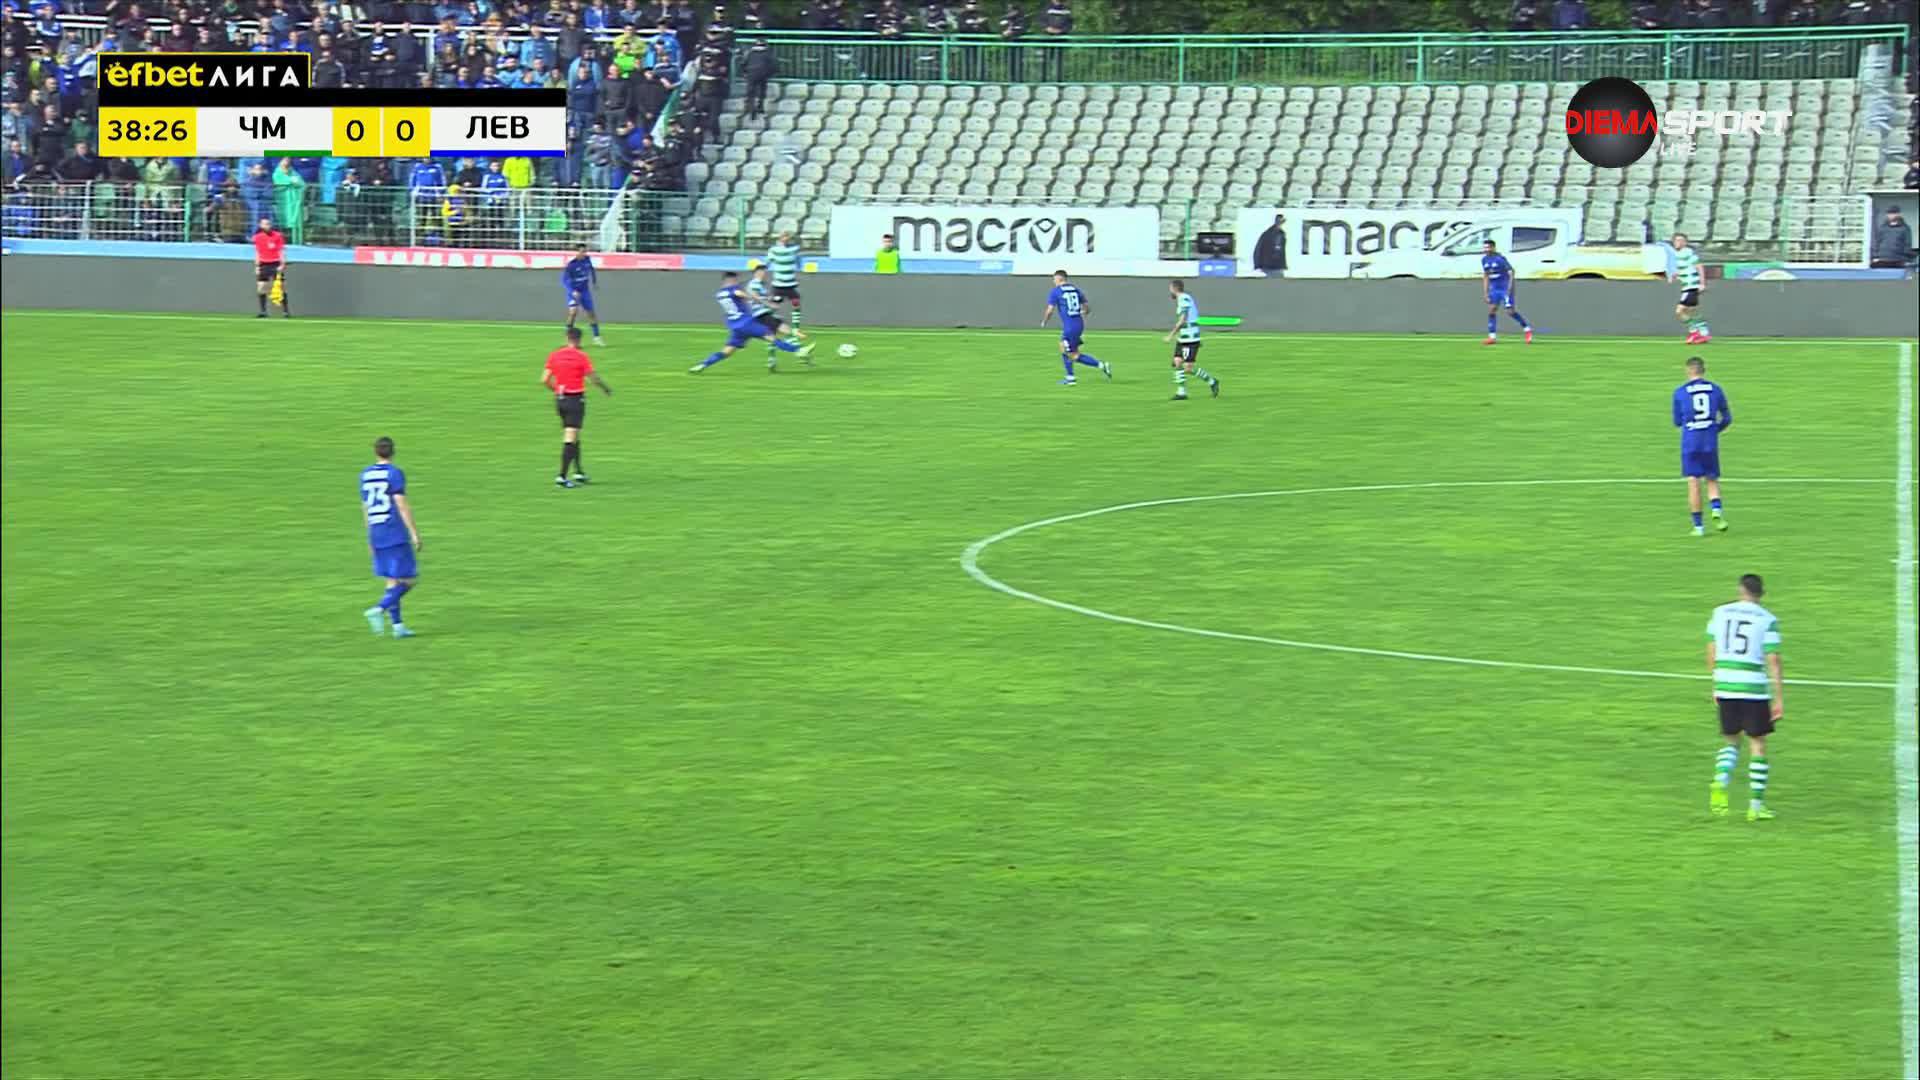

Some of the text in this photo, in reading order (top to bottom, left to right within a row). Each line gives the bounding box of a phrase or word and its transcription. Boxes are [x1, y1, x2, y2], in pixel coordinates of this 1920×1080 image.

[893, 215, 1095, 253] macron
[1301, 219, 1473, 254] macr
[1062, 292, 1079, 311] 18
[1693, 393, 1710, 419] 9
[1725, 619, 1753, 655] 15
